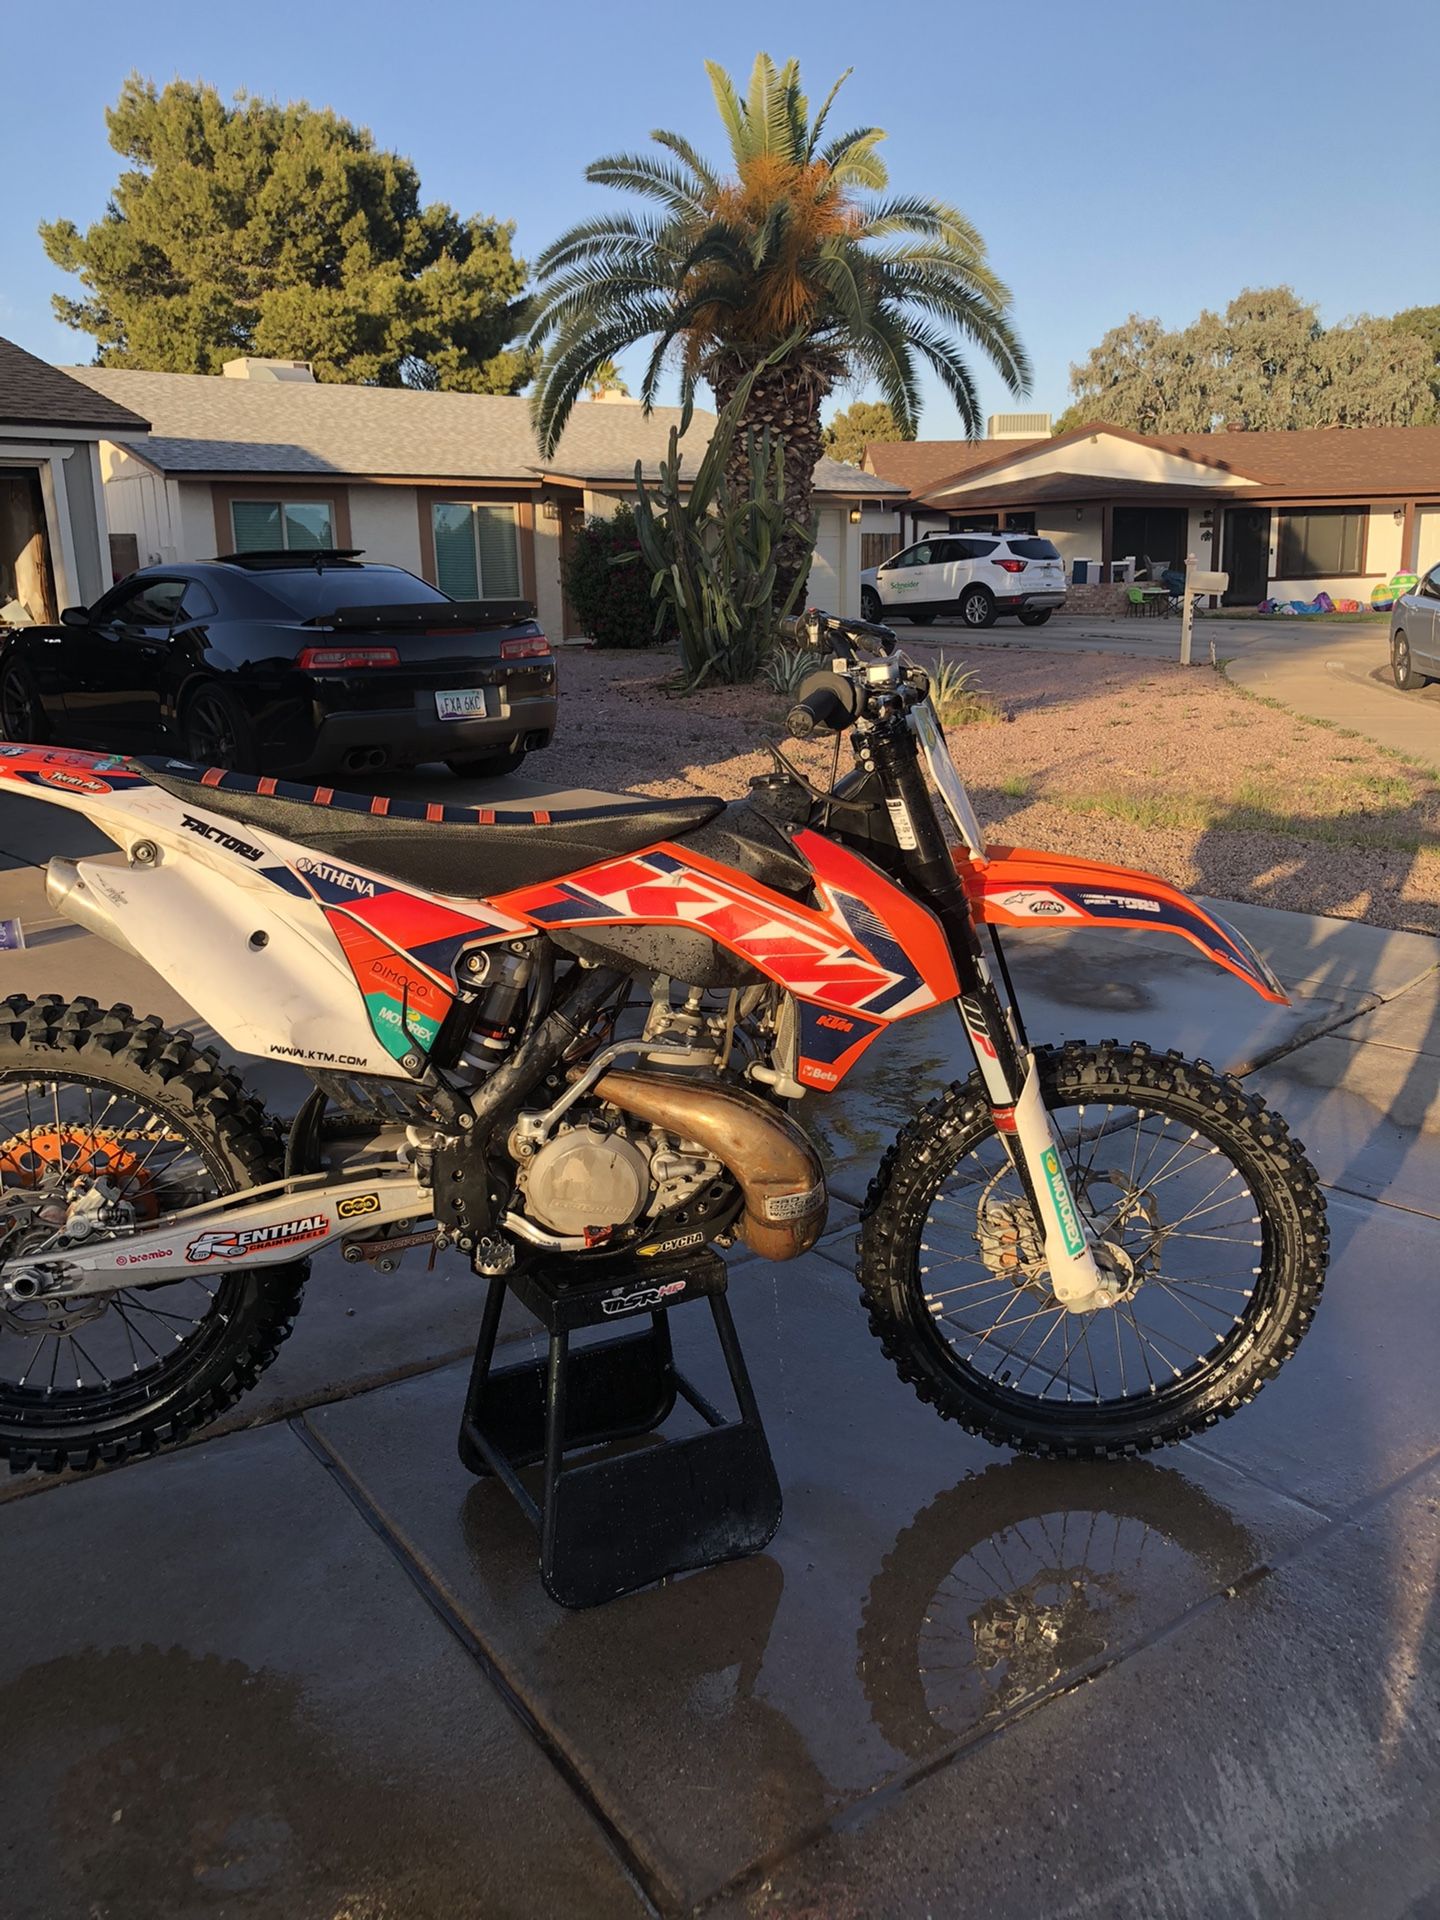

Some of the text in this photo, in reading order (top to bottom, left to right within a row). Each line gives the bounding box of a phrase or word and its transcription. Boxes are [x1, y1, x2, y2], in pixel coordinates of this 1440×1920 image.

[890, 580, 919, 590] Schneider
[50, 771, 103, 791] Twin Air
[180, 813, 265, 862] FACTORY
[310, 863, 375, 898] ATHENA
[371, 961, 428, 998] DIMOCO
[815, 1014, 854, 1033] KTM
[270, 1044, 368, 1067] WWW.KTM.COM
[812, 1067, 838, 1082] Beta
[1051, 1172, 1081, 1249] MOTOREX
[185, 1215, 329, 1262] RENTHAL
[248, 1228, 327, 1252] CHAINWHEELS
[661, 1231, 704, 1252] CYCRA
[128, 1248, 174, 1264] brembo
